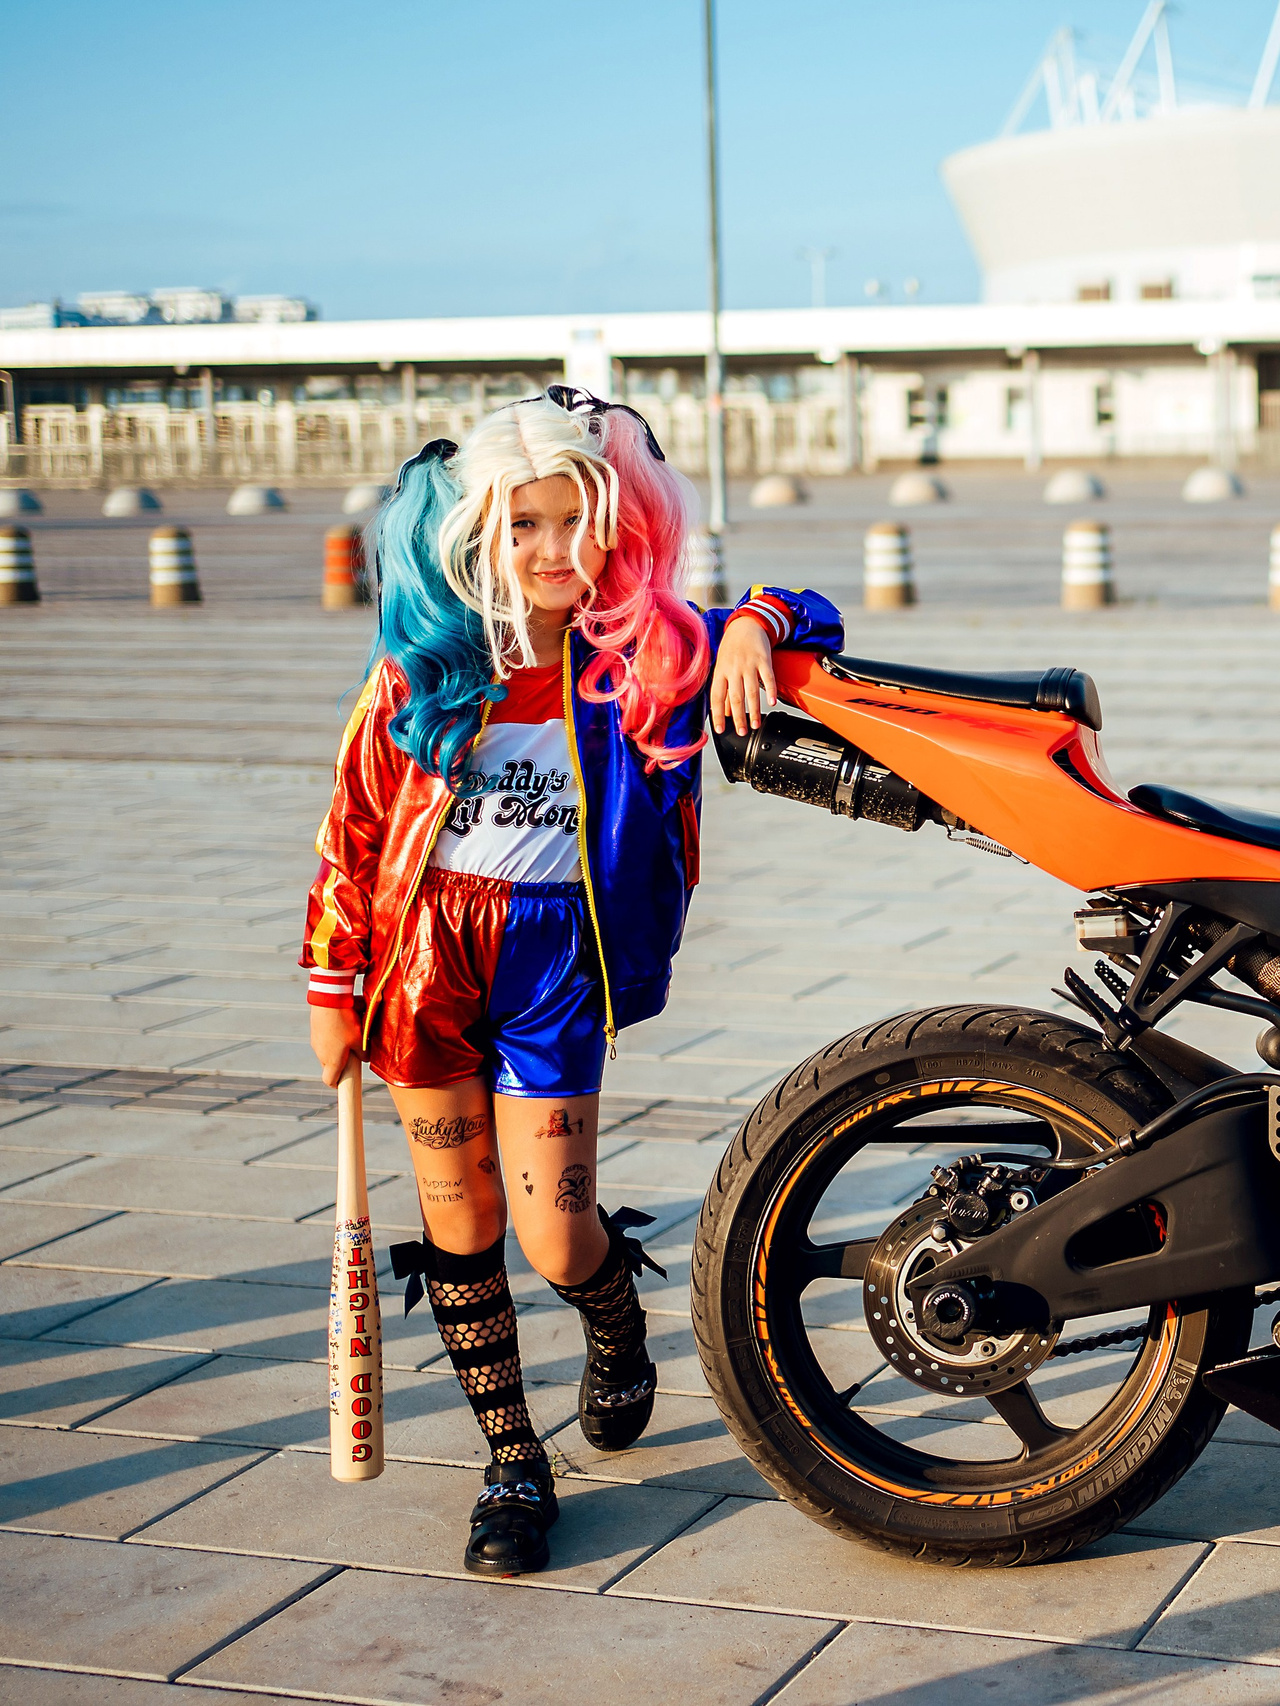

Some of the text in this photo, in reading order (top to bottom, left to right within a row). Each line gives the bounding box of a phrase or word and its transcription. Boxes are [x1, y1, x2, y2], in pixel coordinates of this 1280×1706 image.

[845, 697, 943, 715] 600
[443, 794, 580, 838] Lil Mon
[413, 1115, 487, 1149] Lucky You
[832, 1104, 874, 1138] 600
[559, 1195, 591, 1214] JOKER
[346, 1246, 373, 1358] NIGHT
[350, 1372, 373, 1463] GOOD
[777, 1386, 812, 1428] 600
[1059, 1449, 1100, 1484] 600
[1077, 1402, 1174, 1506] MICHELIN
